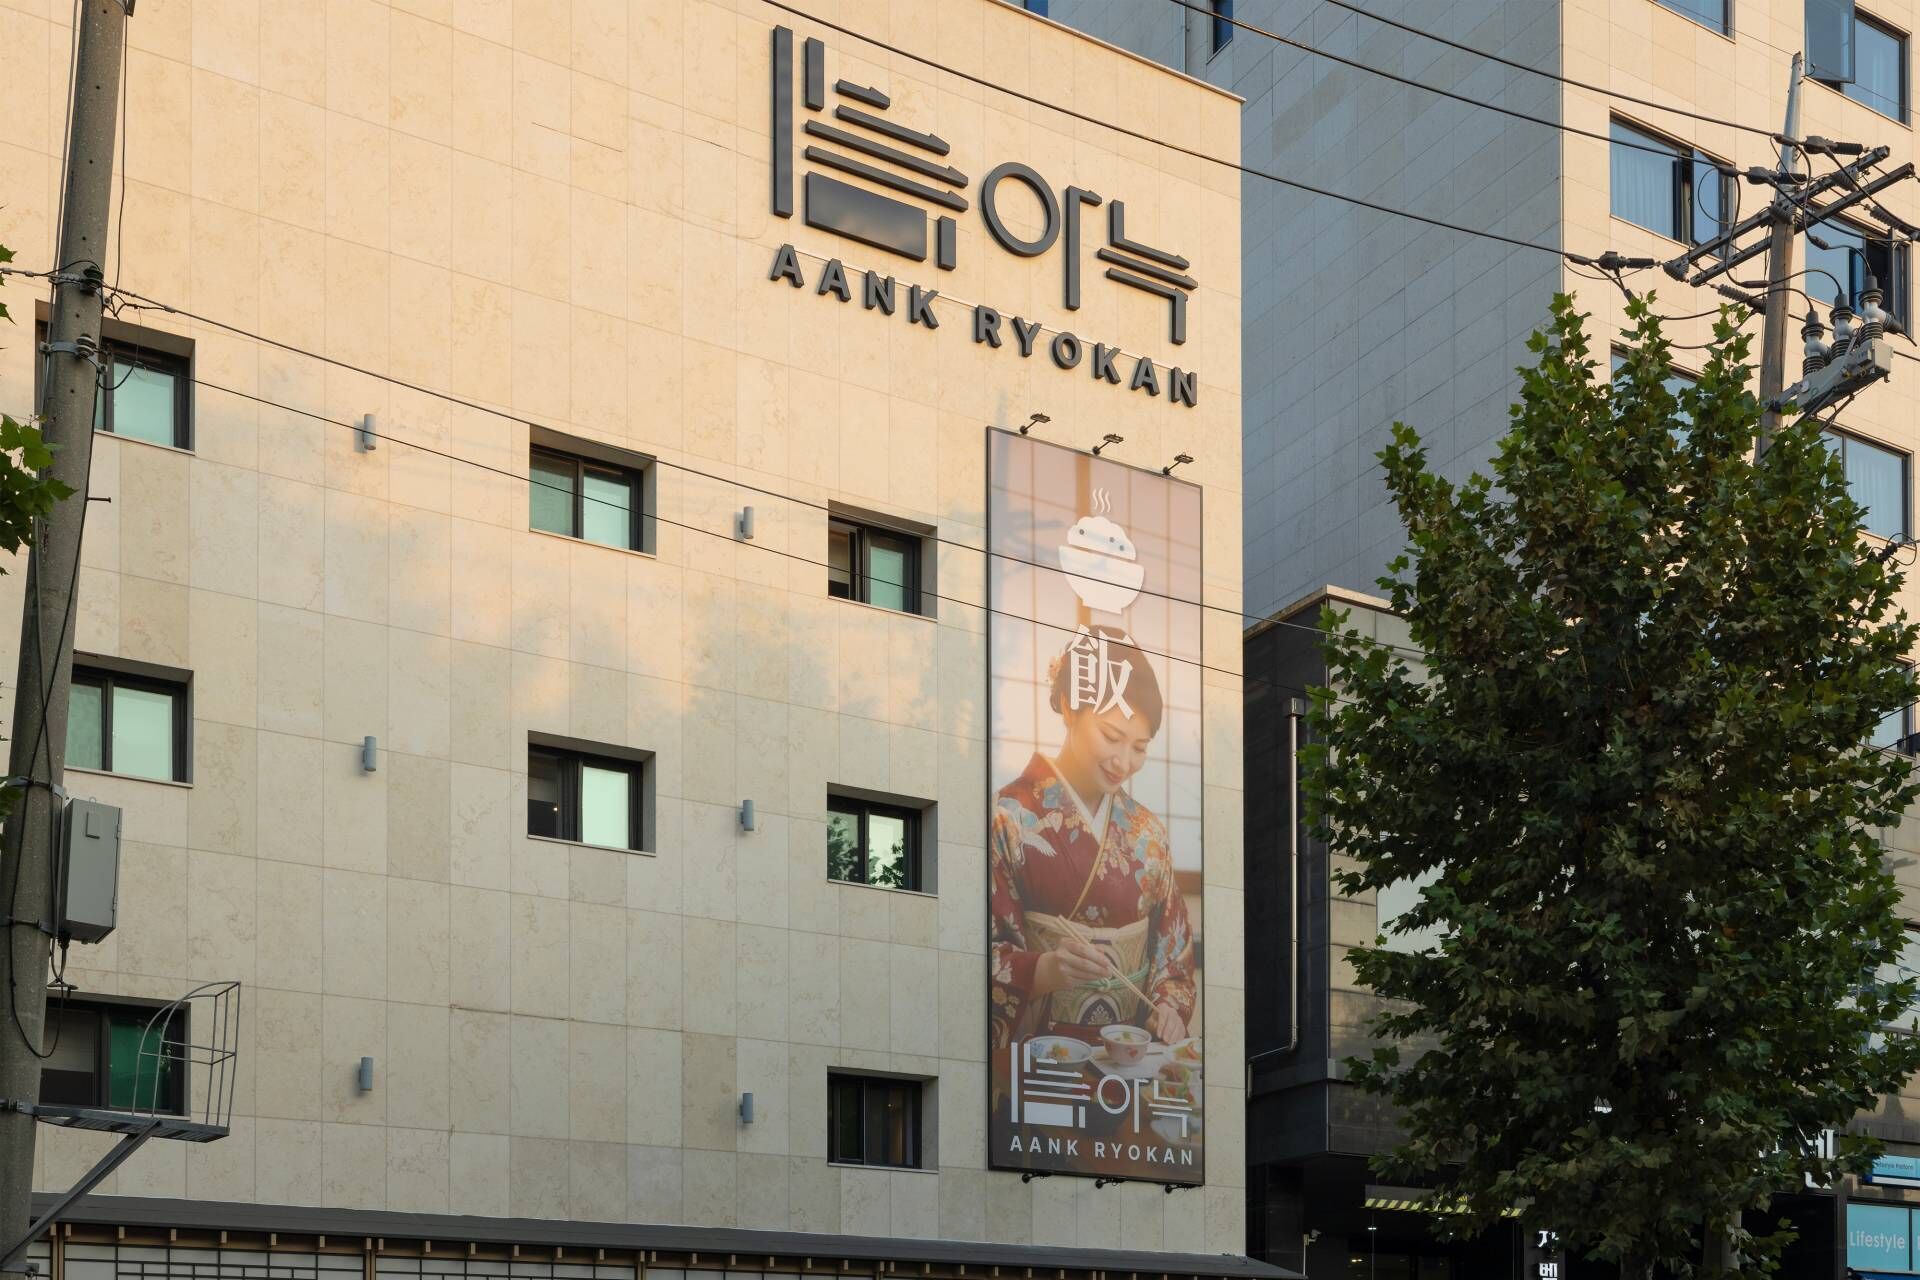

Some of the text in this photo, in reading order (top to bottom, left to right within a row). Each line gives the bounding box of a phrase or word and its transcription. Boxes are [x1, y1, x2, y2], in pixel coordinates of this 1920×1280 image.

[770, 243, 1198, 407] AANK RYOKAN
[1068, 623, 1135, 721] 飯
[1009, 1135, 1193, 1165] AANK RYOKAN
[1849, 1230, 1905, 1253] Lifestyle
